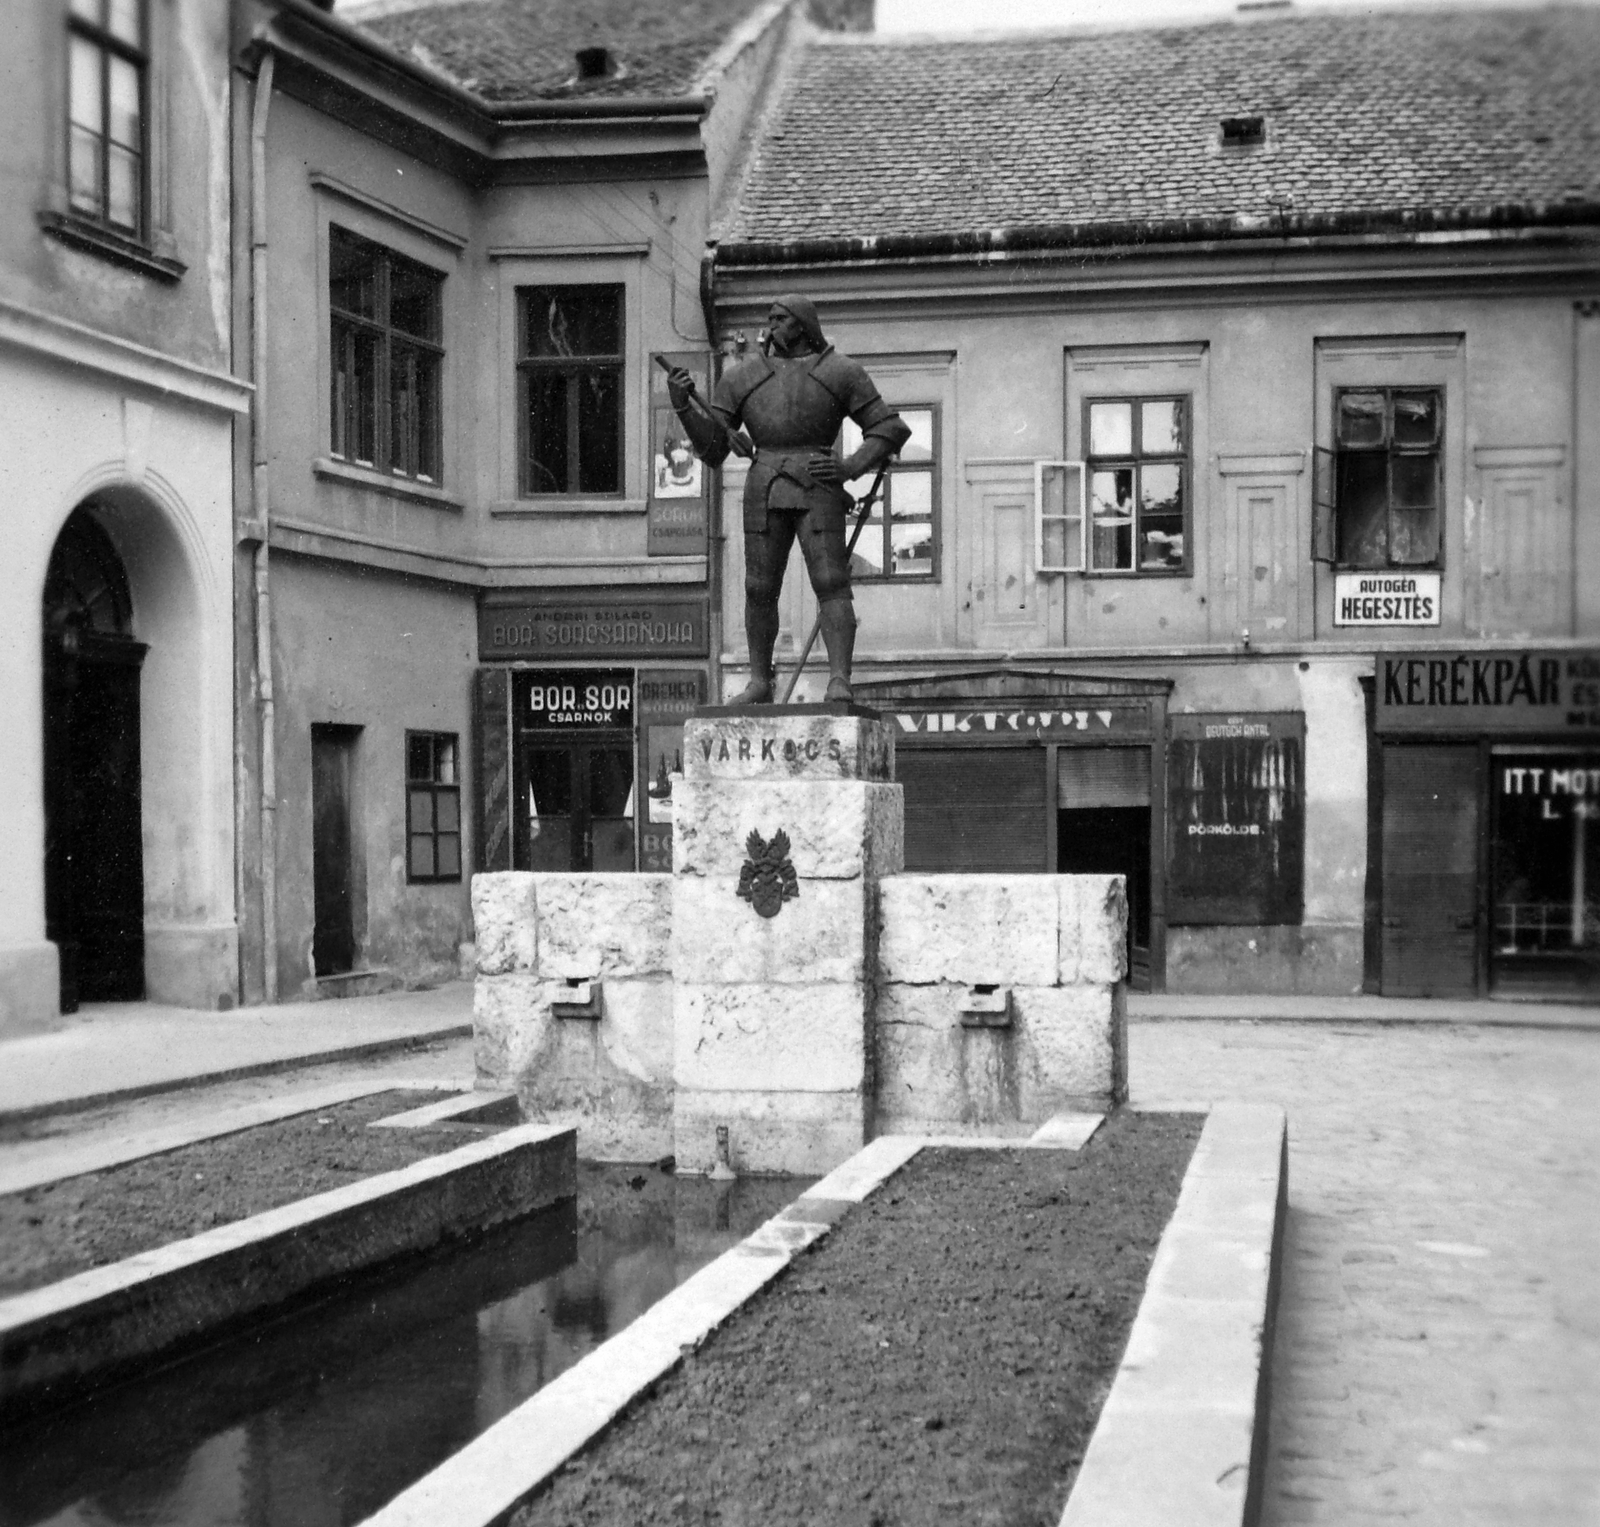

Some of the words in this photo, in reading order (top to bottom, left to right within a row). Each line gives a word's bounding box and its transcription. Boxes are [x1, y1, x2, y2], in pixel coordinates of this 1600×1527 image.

[1360, 579, 1416, 593] AUTOGÉN
[1341, 595, 1433, 620] HEGESZTÉS
[1384, 654, 1560, 706] KERÉKPÁR
[530, 686, 576, 711] BOR
[585, 684, 631, 711] SOR
[548, 712, 612, 723] CSARNOK
[1504, 768, 1544, 795] ITT
